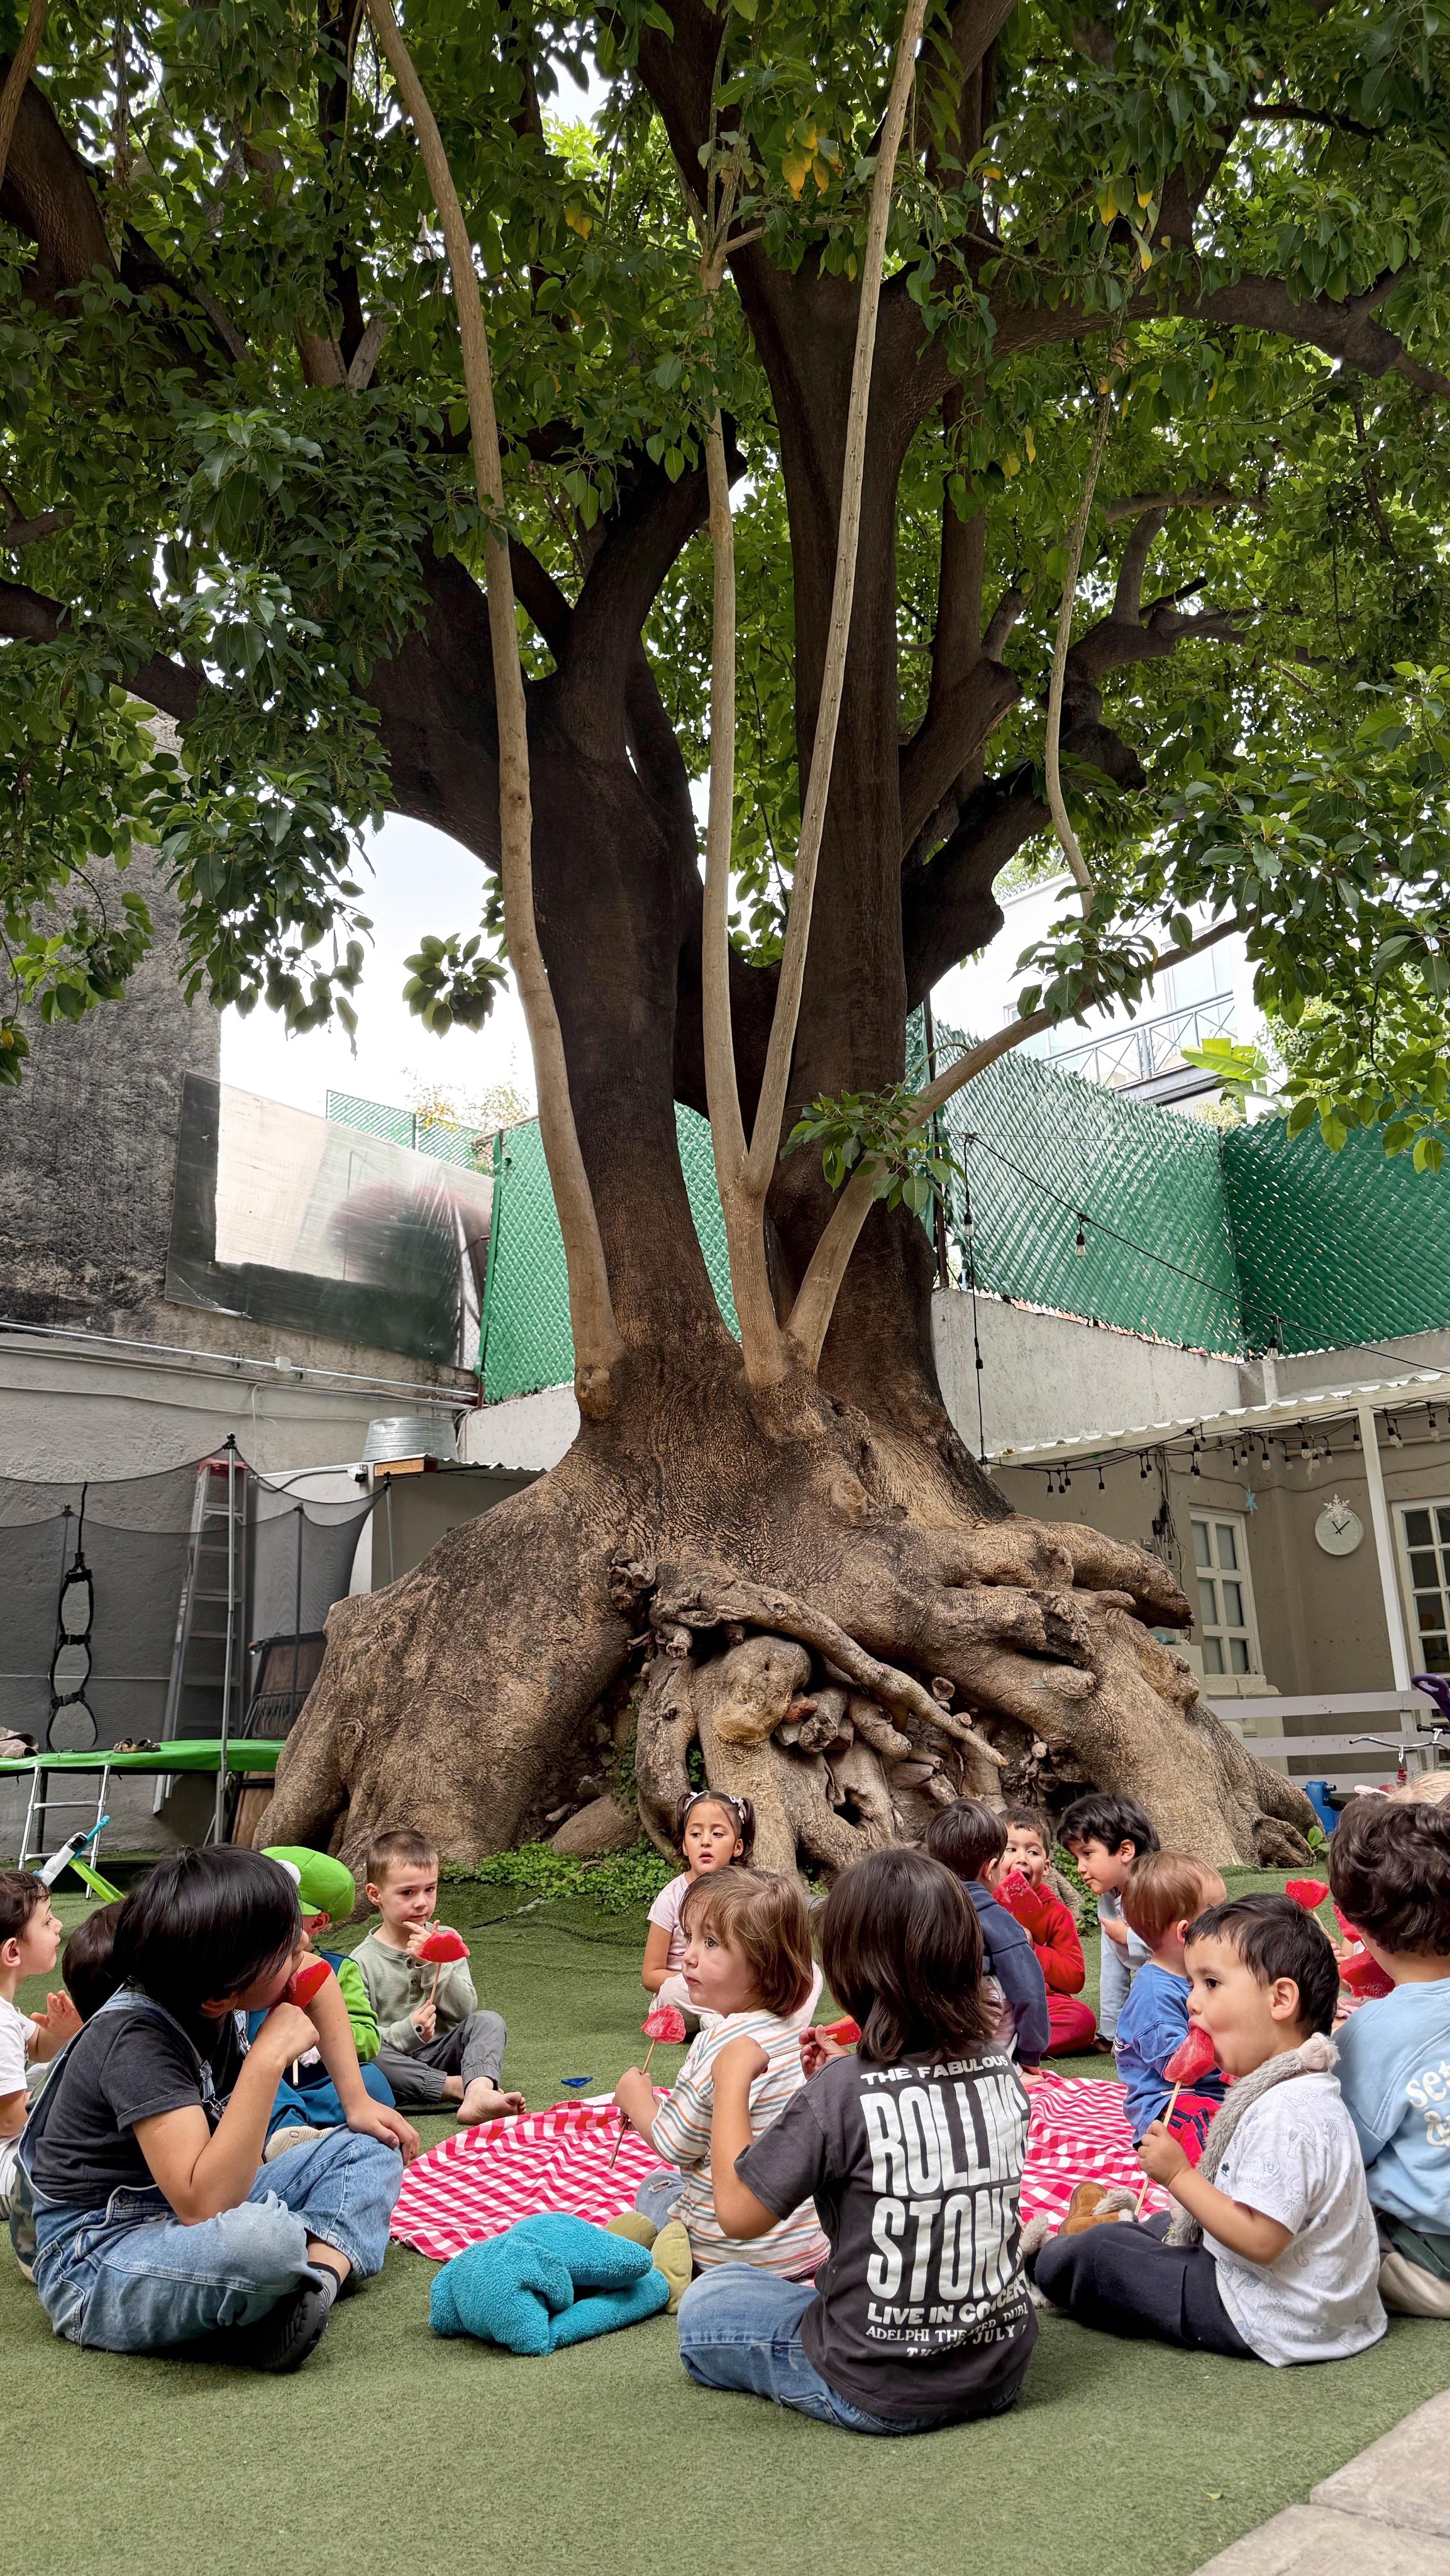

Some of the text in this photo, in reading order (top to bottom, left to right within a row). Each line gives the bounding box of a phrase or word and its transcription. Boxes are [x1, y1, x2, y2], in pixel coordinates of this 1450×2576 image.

[860, 2055, 1009, 2085] THE FABULOUS
[866, 2184, 1022, 2302] STONE
[867, 2269, 1030, 2325] LIVE IN COCERT
[865, 2325, 930, 2342] ADELPHI
[972, 2324, 1016, 2345] JULY
